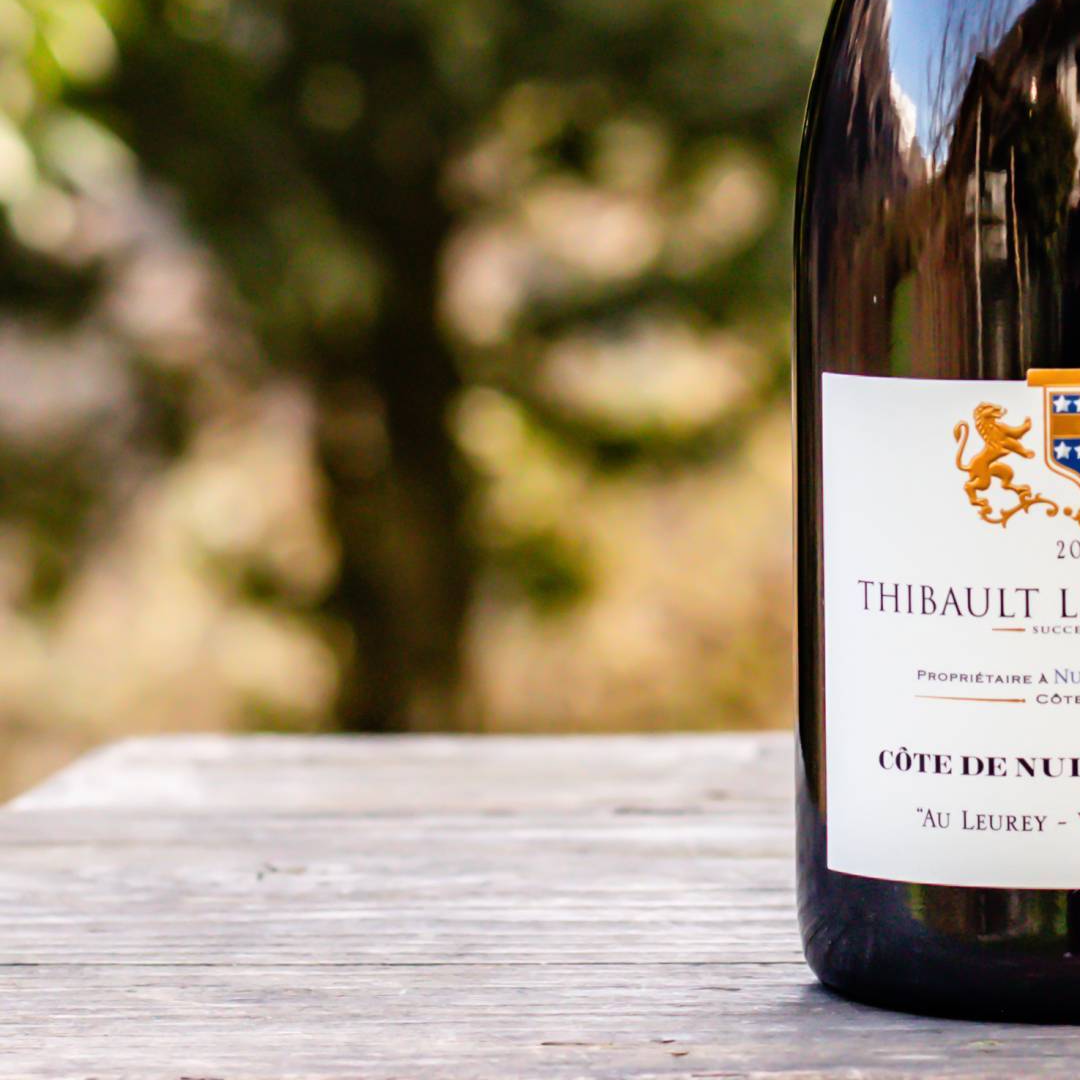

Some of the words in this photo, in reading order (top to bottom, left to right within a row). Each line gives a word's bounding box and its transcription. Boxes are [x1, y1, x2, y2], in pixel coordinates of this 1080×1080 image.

[857, 579, 1040, 619] THIBAULT
[917, 669, 1033, 685] PROPRIÉTAIRE
[878, 746, 953, 776] CÔTE
[959, 755, 1008, 778] DE
[961, 809, 1048, 833] LEUREY
